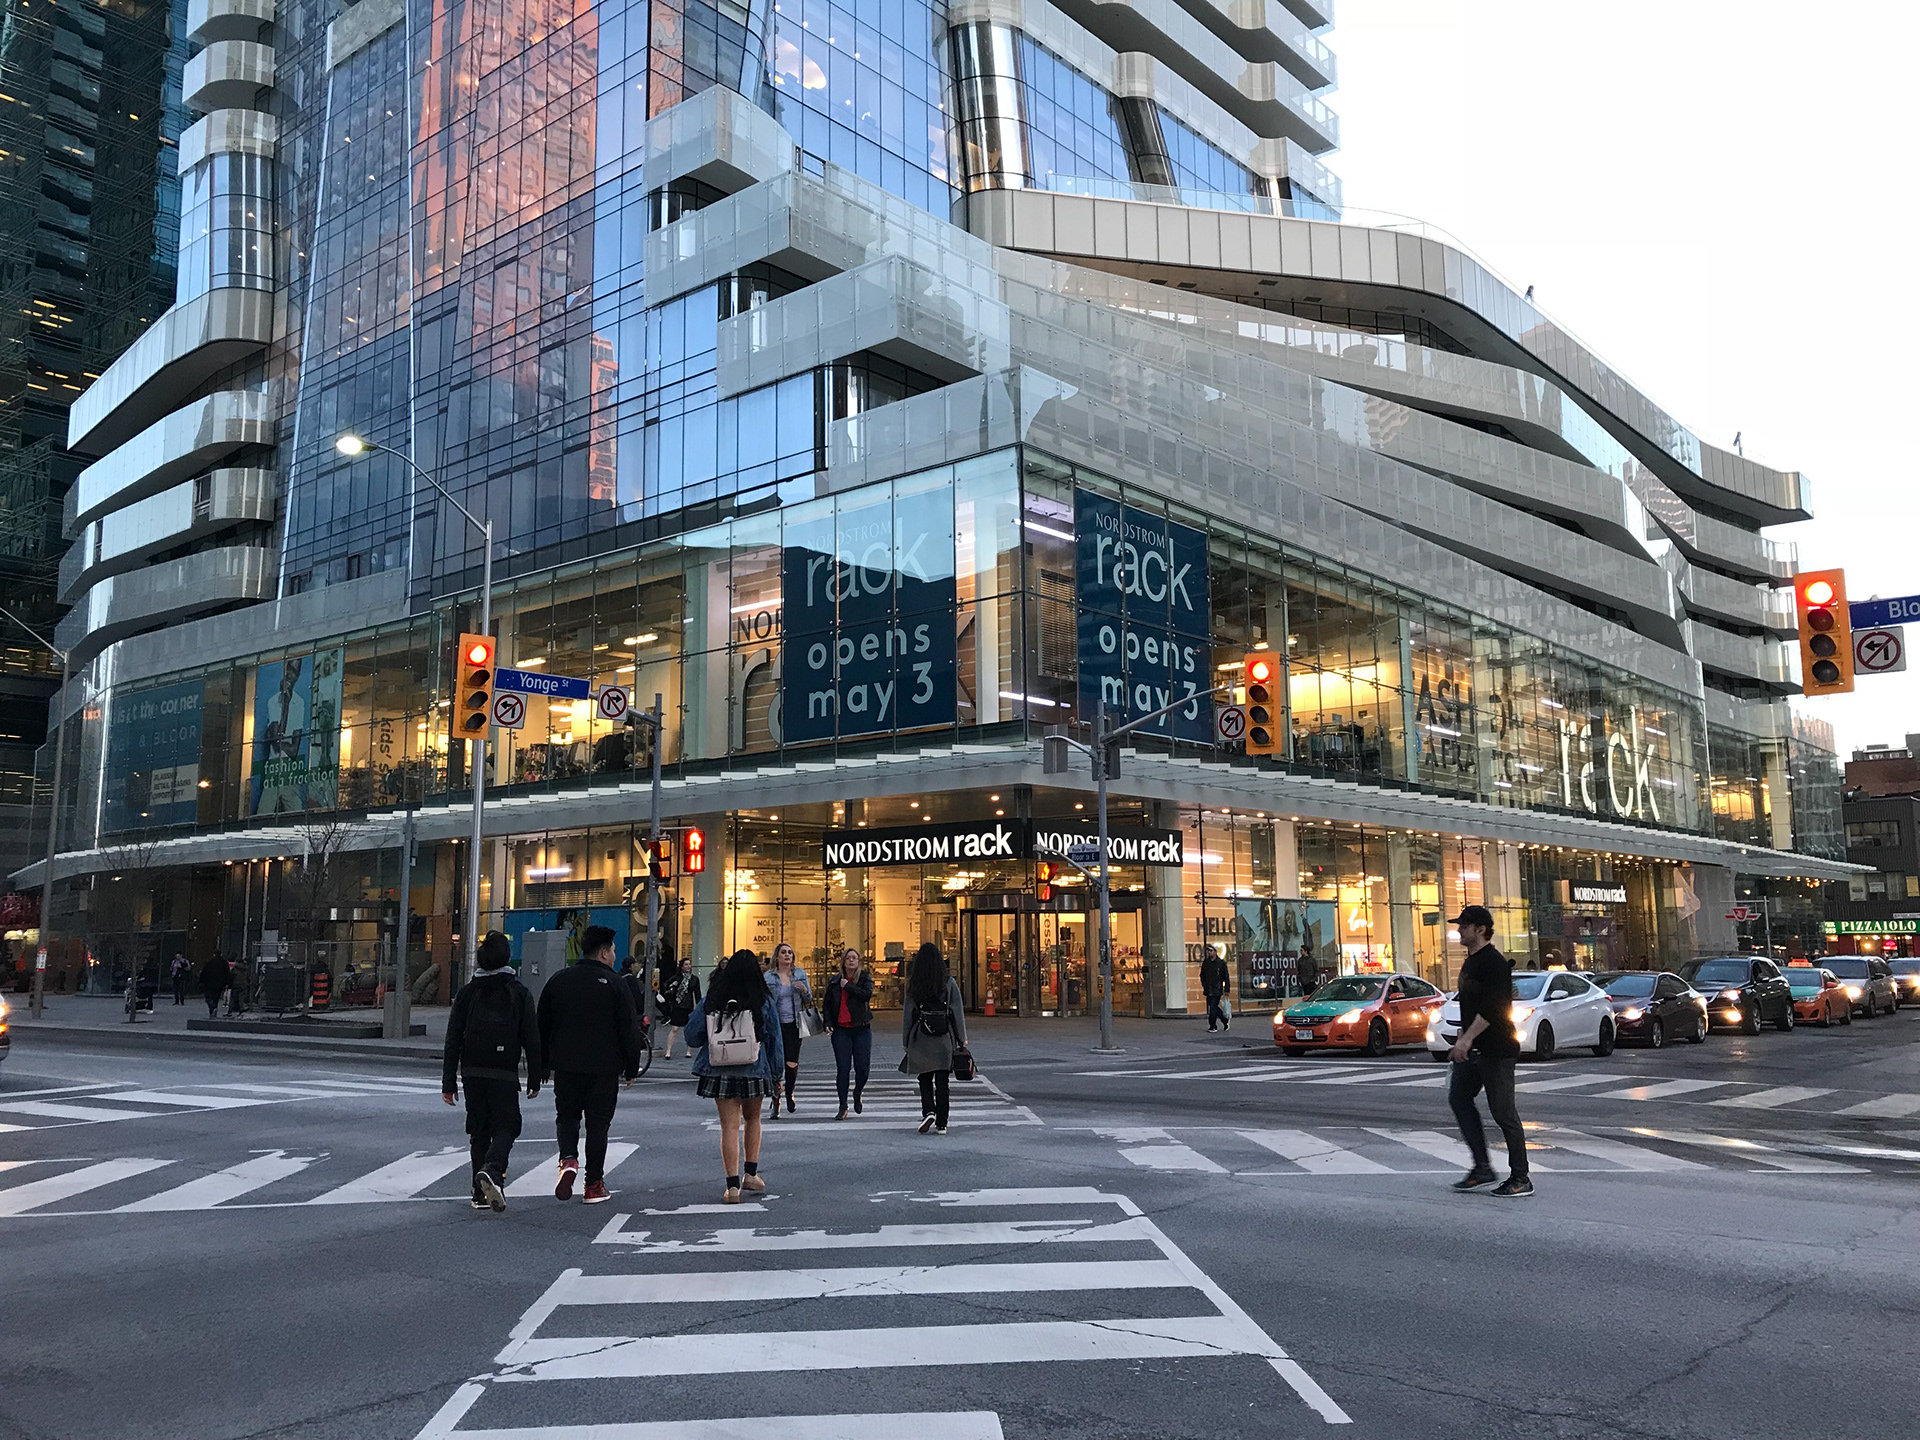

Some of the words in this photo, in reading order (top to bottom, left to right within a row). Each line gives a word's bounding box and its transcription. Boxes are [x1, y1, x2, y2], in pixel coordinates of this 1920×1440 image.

[807, 519, 892, 551] NORDSTROM
[1096, 512, 1166, 549] NORDSTROM
[807, 517, 931, 607] rack
[1096, 533, 1194, 612] rack
[808, 623, 931, 678] opens
[1099, 625, 1195, 673] opens
[520, 673, 559, 694] Yonge
[561, 679, 569, 688] St
[808, 680, 894, 722] may
[912, 661, 934, 704] 3
[160, 693, 199, 716] corner
[1101, 674, 1170, 727] may
[1183, 681, 1199, 721] 3
[153, 725, 197, 746] BLOOR
[264, 757, 304, 775] fashion
[1559, 704, 1661, 822] rack
[263, 776, 275, 789] at
[289, 768, 334, 786] fraction
[825, 836, 950, 865] NORDSTROM
[953, 824, 1013, 858] rack
[1036, 831, 1139, 861] NORROM
[1140, 834, 1181, 863] rack
[1071, 853, 1084, 861] Bloor
[1091, 852, 1095, 861] E
[1574, 887, 1611, 902] NORDSTROM
[1611, 885, 1627, 903] rack
[1196, 917, 1236, 937] HELLO
[1841, 920, 1917, 931] PIZZAIOLO
[1252, 952, 1296, 971] fashion
[1252, 973, 1265, 988] at
